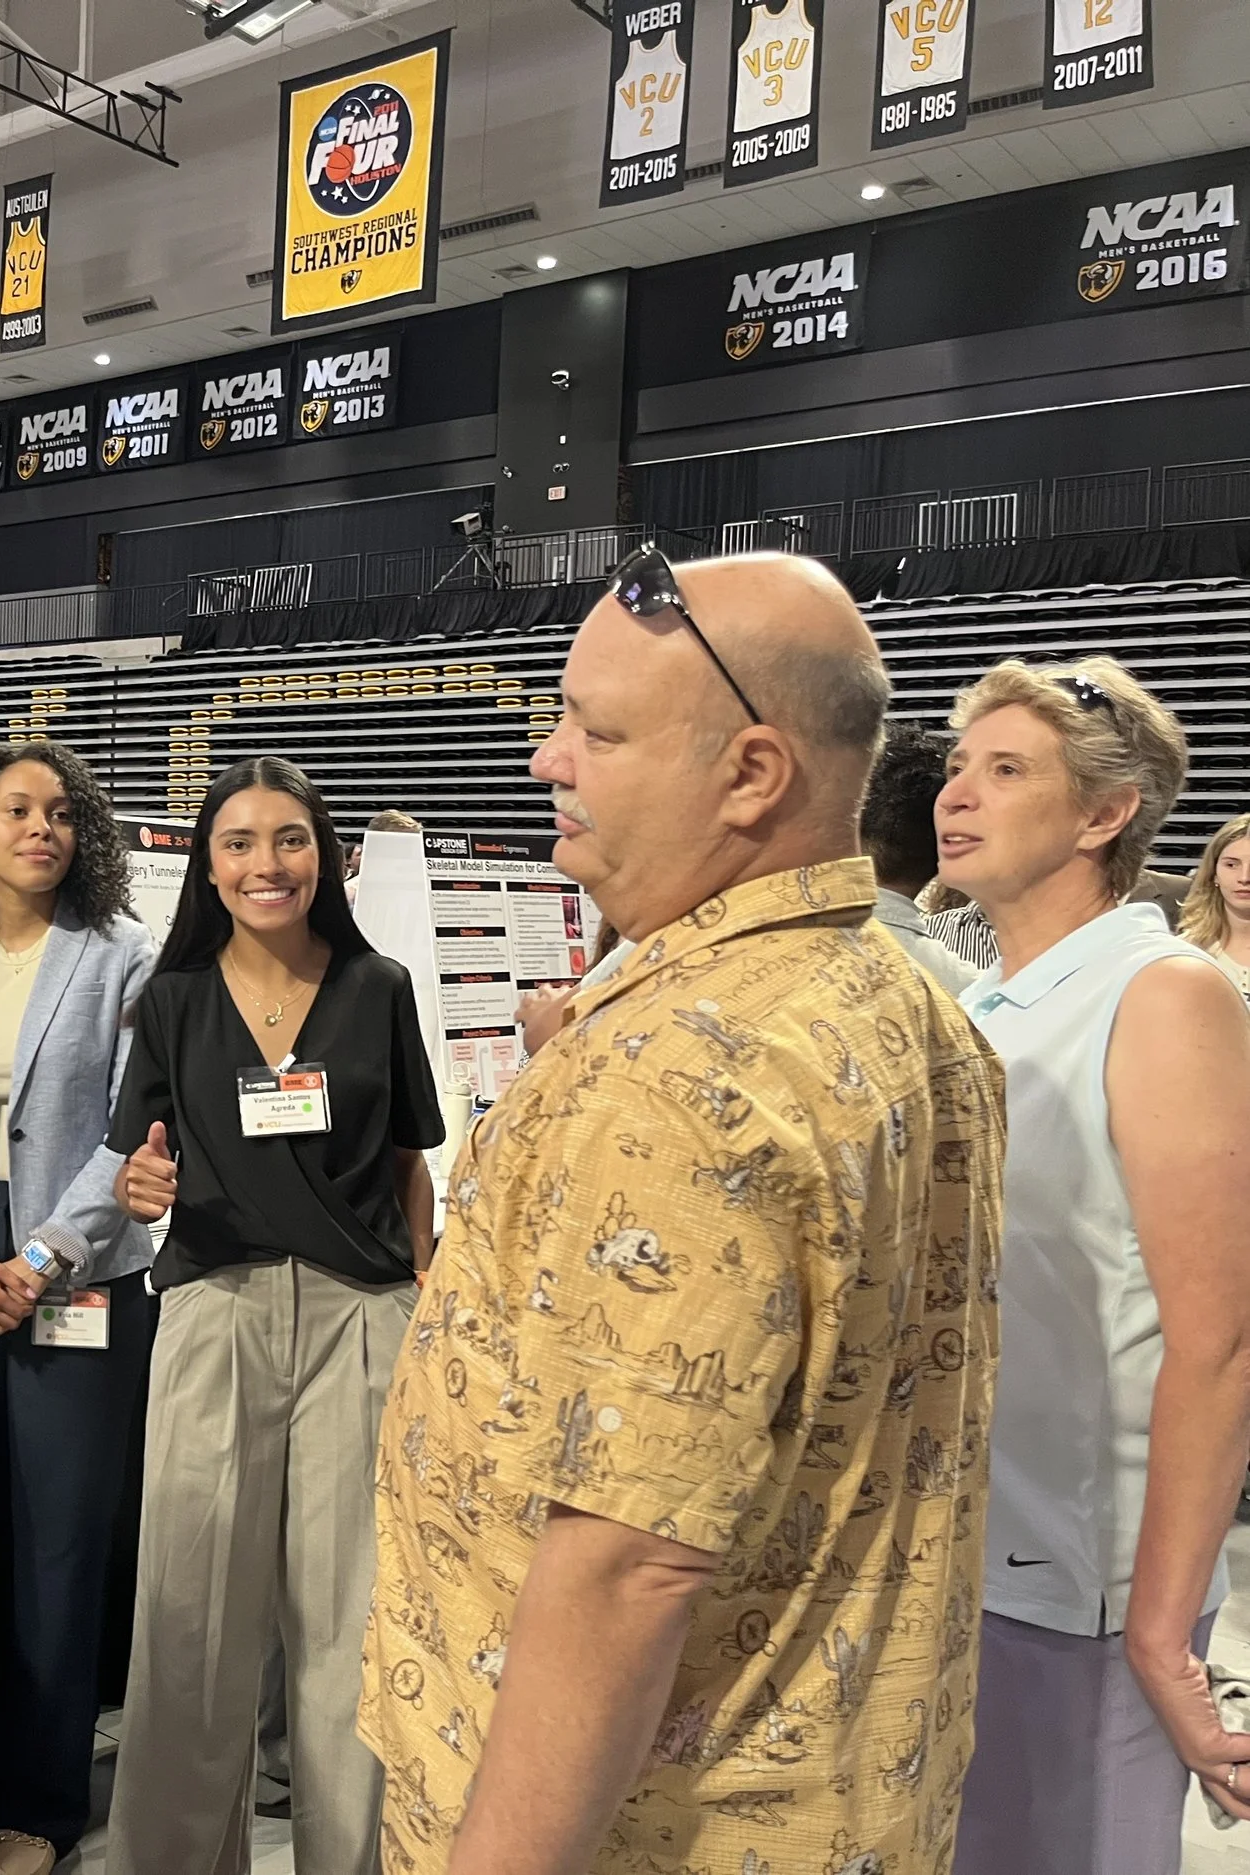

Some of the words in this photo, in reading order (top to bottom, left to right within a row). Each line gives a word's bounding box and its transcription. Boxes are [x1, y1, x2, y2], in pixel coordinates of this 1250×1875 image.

[626, 3, 681, 37] WEBER
[891, 0, 963, 40] VCU
[1084, 0, 1113, 29] 12
[743, 38, 809, 79] VCU
[911, 37, 935, 71] 5
[1053, 46, 1143, 91] 2007-2011
[619, 73, 681, 110] VCU
[764, 74, 783, 106] 3
[374, 100, 398, 116] 2011
[639, 107, 654, 137] 2
[881, 91, 956, 134] 1981-1985
[335, 110, 399, 147] FINAL
[732, 125, 809, 168] 2005-2009
[350, 164, 401, 185] HOUSTON
[609, 154, 677, 190] 2011-2015
[293, 223, 359, 250] SOUTHWEST
[363, 207, 418, 235] REGIONAL
[1080, 185, 1235, 249] NCAA
[8, 251, 42, 275] VCU
[291, 221, 417, 275] CHAMPIONS
[1099, 245, 1136, 258] MEN'S
[12, 275, 28, 297] 21
[727, 252, 856, 312] NCAA
[1136, 249, 1227, 291] 2016
[742, 307, 774, 320] MEN'S
[777, 297, 844, 314] BASKETBALL
[3, 314, 42, 340] 1999-2003
[772, 311, 848, 349] 2014
[302, 347, 390, 392] NCAA
[202, 368, 282, 411] NCAA
[337, 382, 382, 396] BASKETBALL
[19, 405, 87, 445] NCAA
[105, 388, 179, 428] NCAA
[333, 395, 386, 424] 2013
[230, 414, 278, 442] 2012
[43, 446, 87, 473] 2009
[128, 433, 168, 459] 2011
[153, 833, 172, 846] BME
[426, 838, 466, 848] CAPSTONE
[427, 859, 458, 870] Skeletal
[460, 860, 483, 871] Model
[486, 861, 523, 872] Simulation
[525, 862, 534, 872] for
